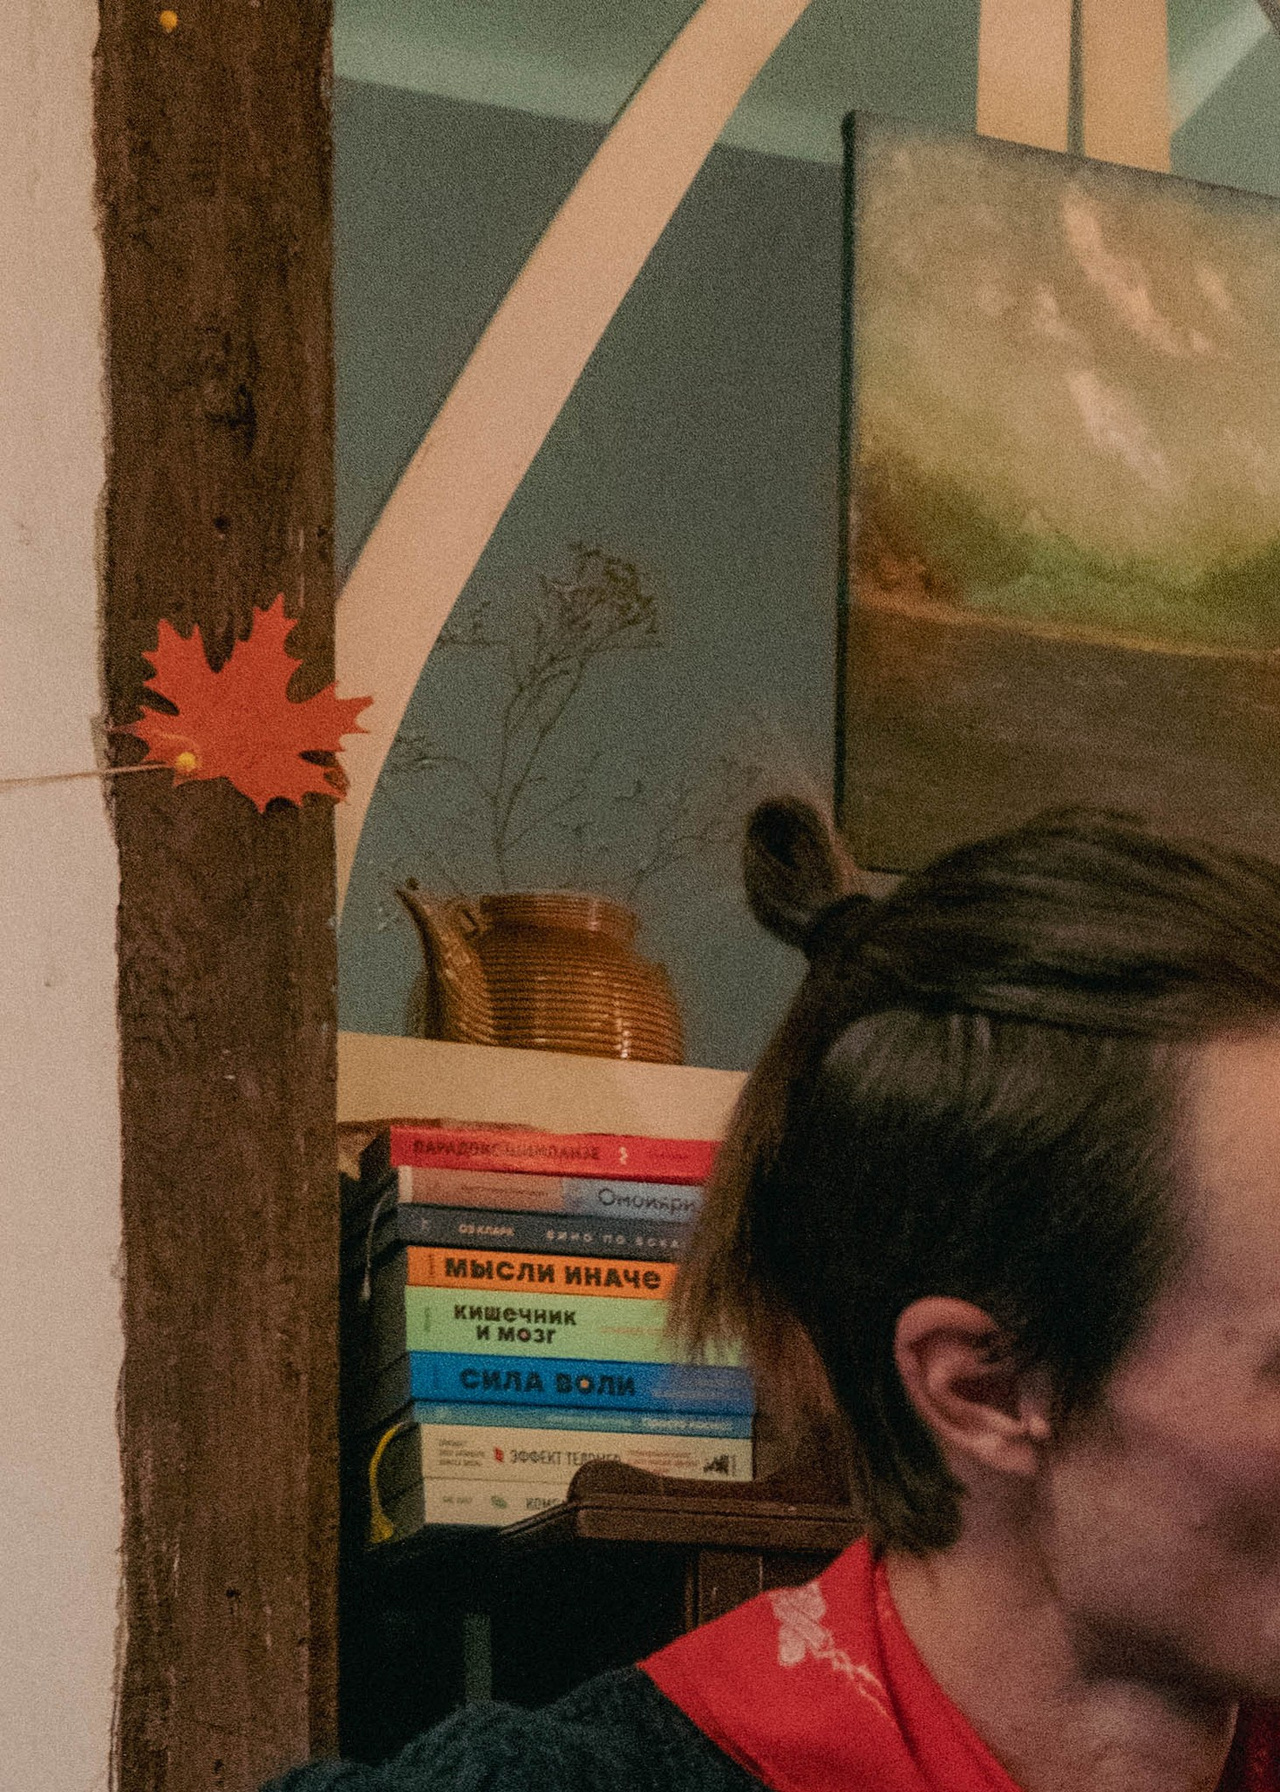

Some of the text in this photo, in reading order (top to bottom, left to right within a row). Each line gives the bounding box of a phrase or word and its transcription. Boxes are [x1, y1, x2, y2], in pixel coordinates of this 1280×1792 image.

[412, 1139, 501, 1158] ПАРАДОКС
[545, 1230, 593, 1244] ВИНО
[602, 1233, 626, 1246] ПО
[445, 1257, 555, 1284] МЫСЛИ
[476, 1326, 557, 1345] И МОЗГ
[459, 1367, 545, 1394] СИЛА
[556, 1369, 636, 1397] ВОЛИ
[510, 1448, 562, 1465] ЭФФЕКТ
